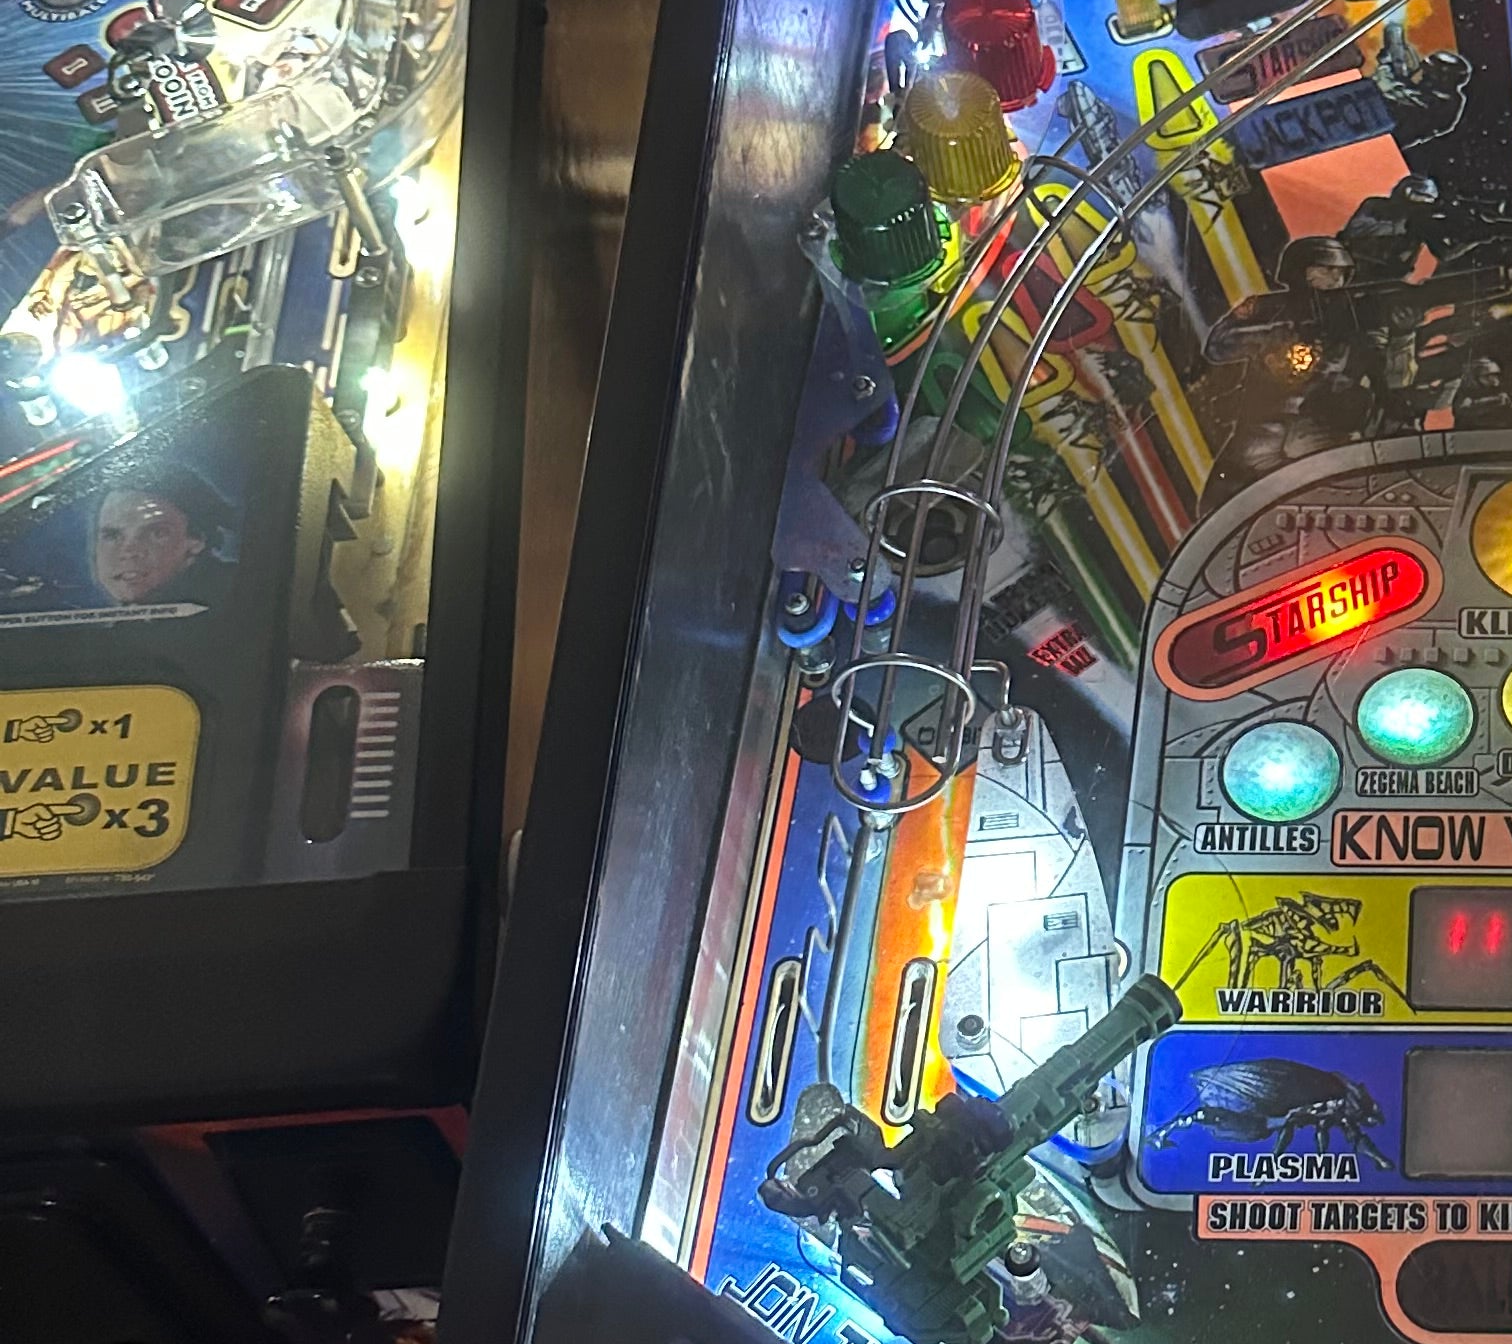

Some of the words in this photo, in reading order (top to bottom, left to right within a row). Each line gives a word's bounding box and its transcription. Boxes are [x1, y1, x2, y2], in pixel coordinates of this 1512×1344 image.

[1240, 88, 1394, 160] JACKPOT
[1213, 560, 1399, 660] STARSHIP
[88, 713, 133, 740] x1
[0, 762, 177, 794] VALUE
[1359, 771, 1420, 795] ZEGEMA
[1424, 771, 1475, 795] BEACH
[101, 798, 170, 838] x3
[1200, 826, 1317, 852] ANTILLES
[1337, 814, 1485, 862] KNOW
[1216, 987, 1386, 1017] WARRIOR
[1208, 1153, 1361, 1183] PLASMA
[1209, 1201, 1304, 1232] SHOOT
[1310, 1202, 1426, 1232] TARGETS
[1435, 1203, 1470, 1232] TO
